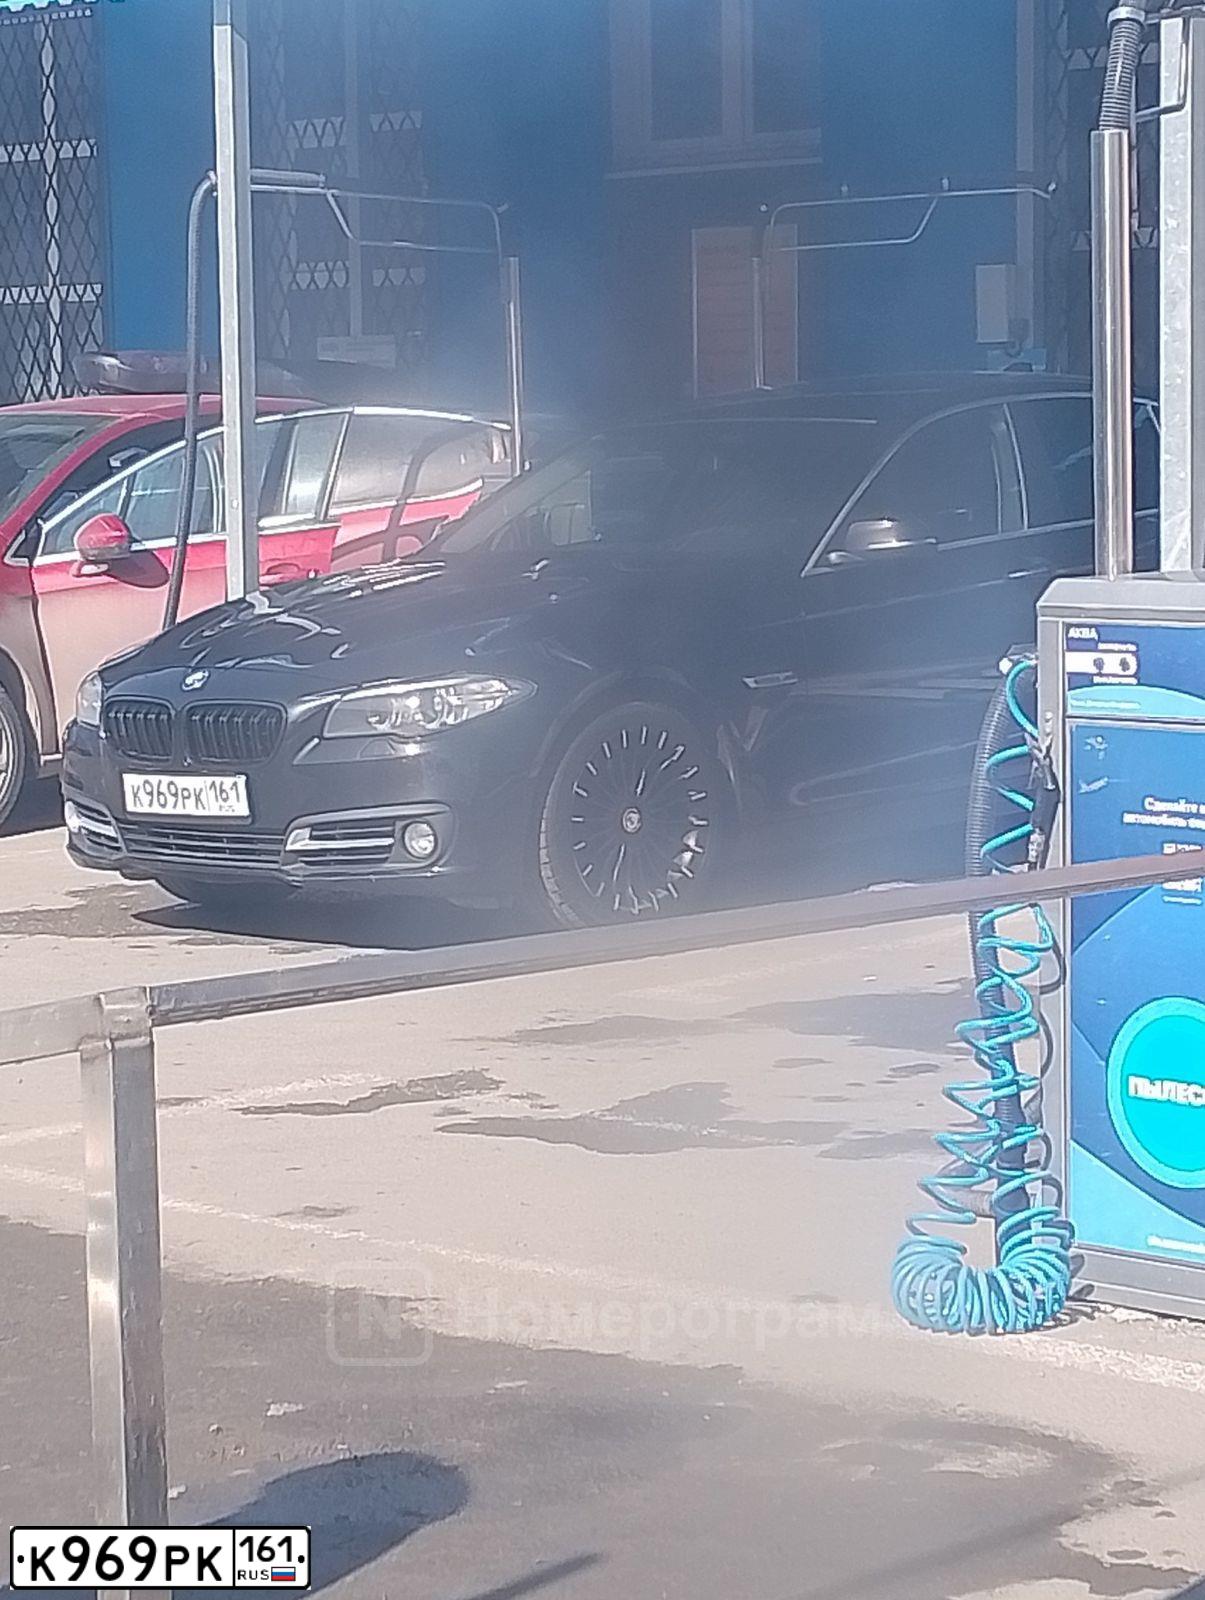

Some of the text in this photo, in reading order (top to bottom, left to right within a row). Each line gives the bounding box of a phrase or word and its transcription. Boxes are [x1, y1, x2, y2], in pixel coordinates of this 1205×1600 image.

[131, 779, 241, 811] К969РК 161
[1127, 1074, 1205, 1107] ПЫЛЕС
